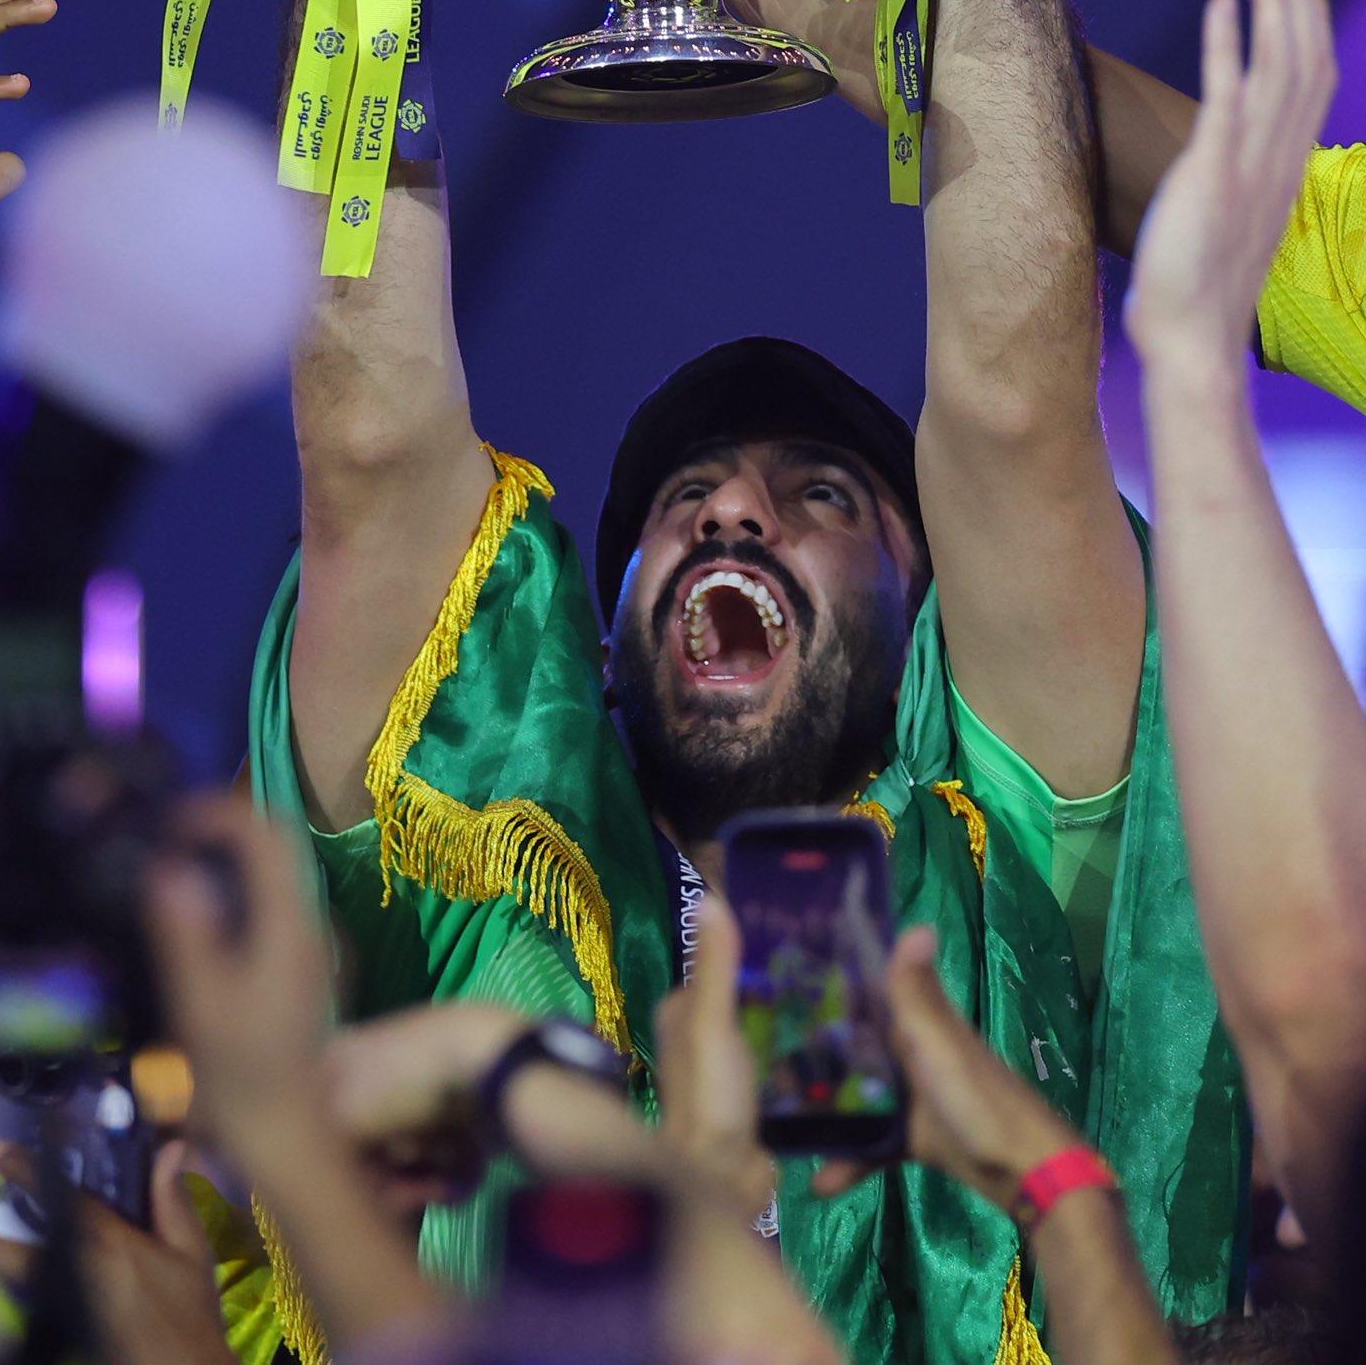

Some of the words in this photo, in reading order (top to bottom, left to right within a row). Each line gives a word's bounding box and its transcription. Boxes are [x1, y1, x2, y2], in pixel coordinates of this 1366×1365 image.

[895, 32, 913, 100] السعودي
[294, 91, 312, 158] السعودي
[316, 94, 333, 129] روشن
[352, 127, 365, 160] ROSHN
[359, 95, 371, 124] SAUDI
[365, 96, 389, 161] LEAGUE
[311, 130, 324, 160] دوري
[680, 885, 704, 954] SAUDI
